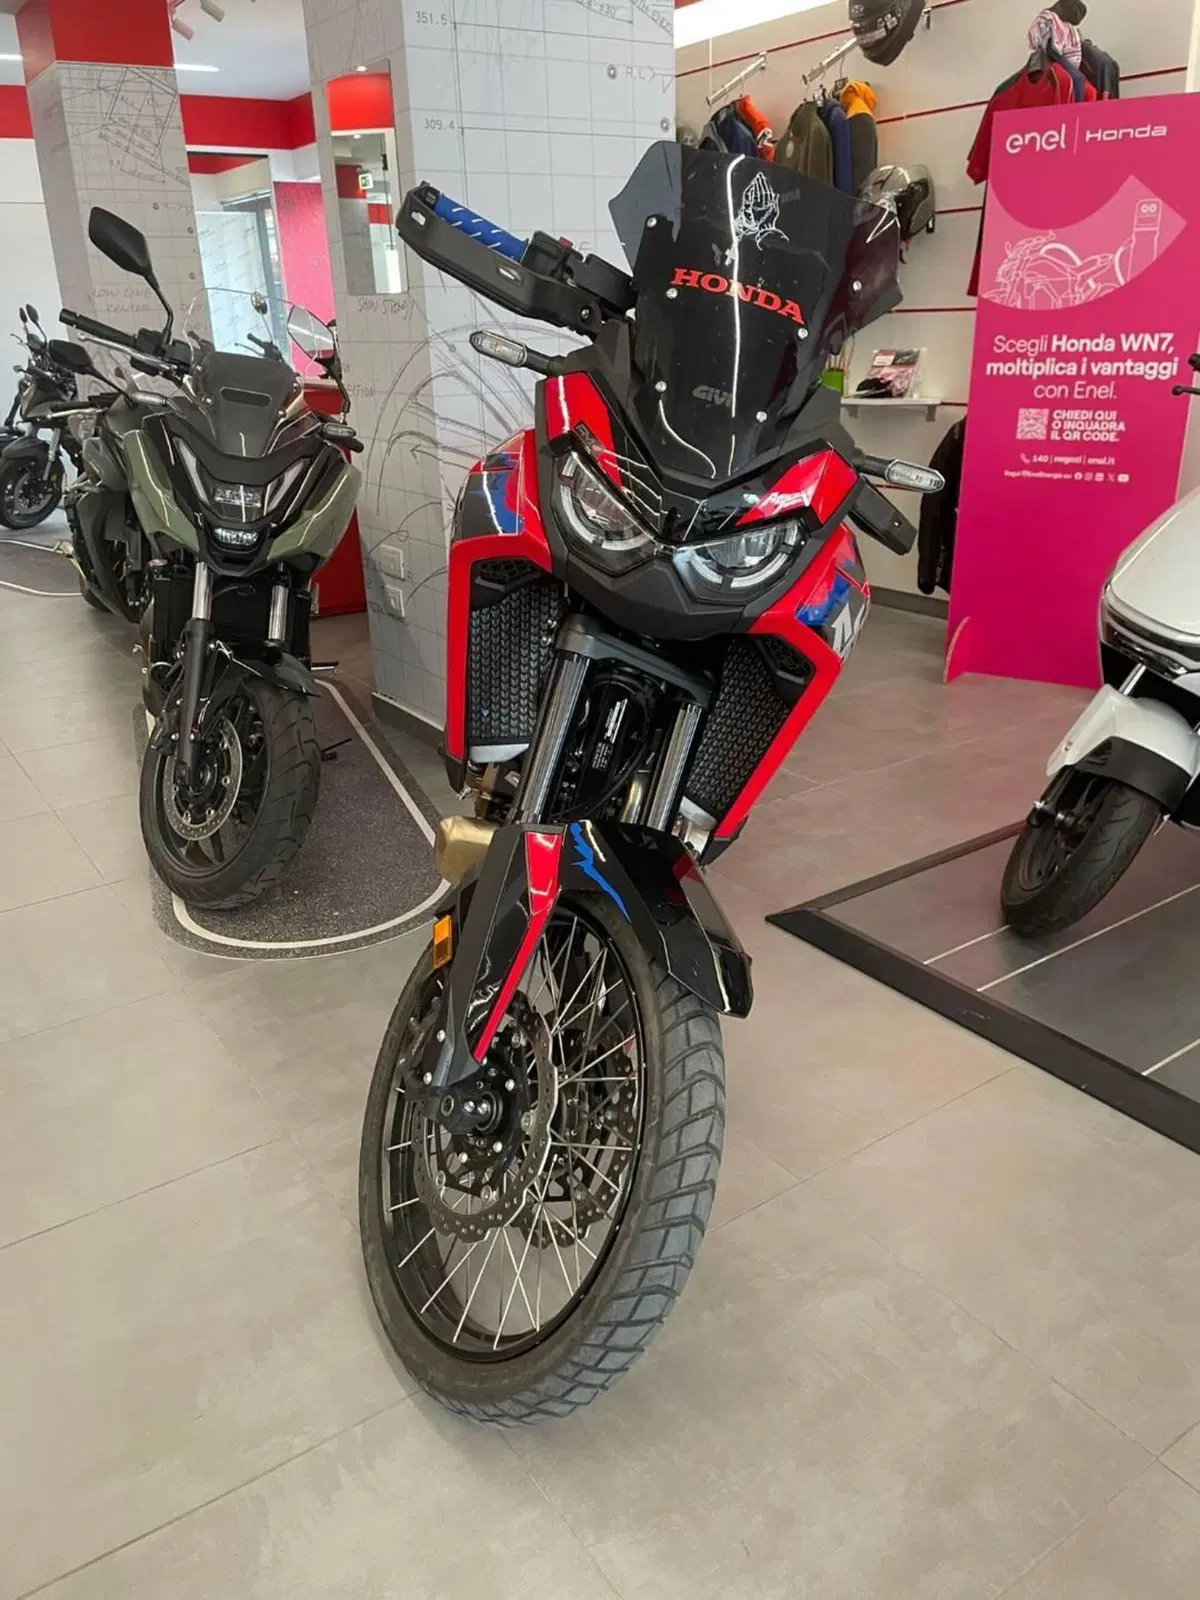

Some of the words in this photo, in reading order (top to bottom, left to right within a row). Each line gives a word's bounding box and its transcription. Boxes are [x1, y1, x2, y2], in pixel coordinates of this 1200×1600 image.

[415, 11, 448, 26] 351.5
[423, 117, 455, 131] 309.4
[1005, 123, 1066, 154] enel
[1085, 123, 1167, 142] Honda
[670, 267, 805, 325] HONDA
[993, 334, 1049, 357] Scegli
[1051, 333, 1115, 353] Honda
[1120, 332, 1175, 354] WN7,
[985, 357, 1078, 380] moltiplica
[1080, 357, 1088, 376] i
[1090, 356, 1180, 381] vantaggi
[1033, 383, 1069, 399] con
[1073, 380, 1118, 400] Enel.
[1052, 409, 1093, 421] CHIEDI
[1094, 410, 1118, 421] QUI
[1051, 420, 1062, 430] O
[1063, 421, 1126, 432] INQUADRA
[1050, 431, 1061, 441] IL
[1062, 431, 1080, 441] QR
